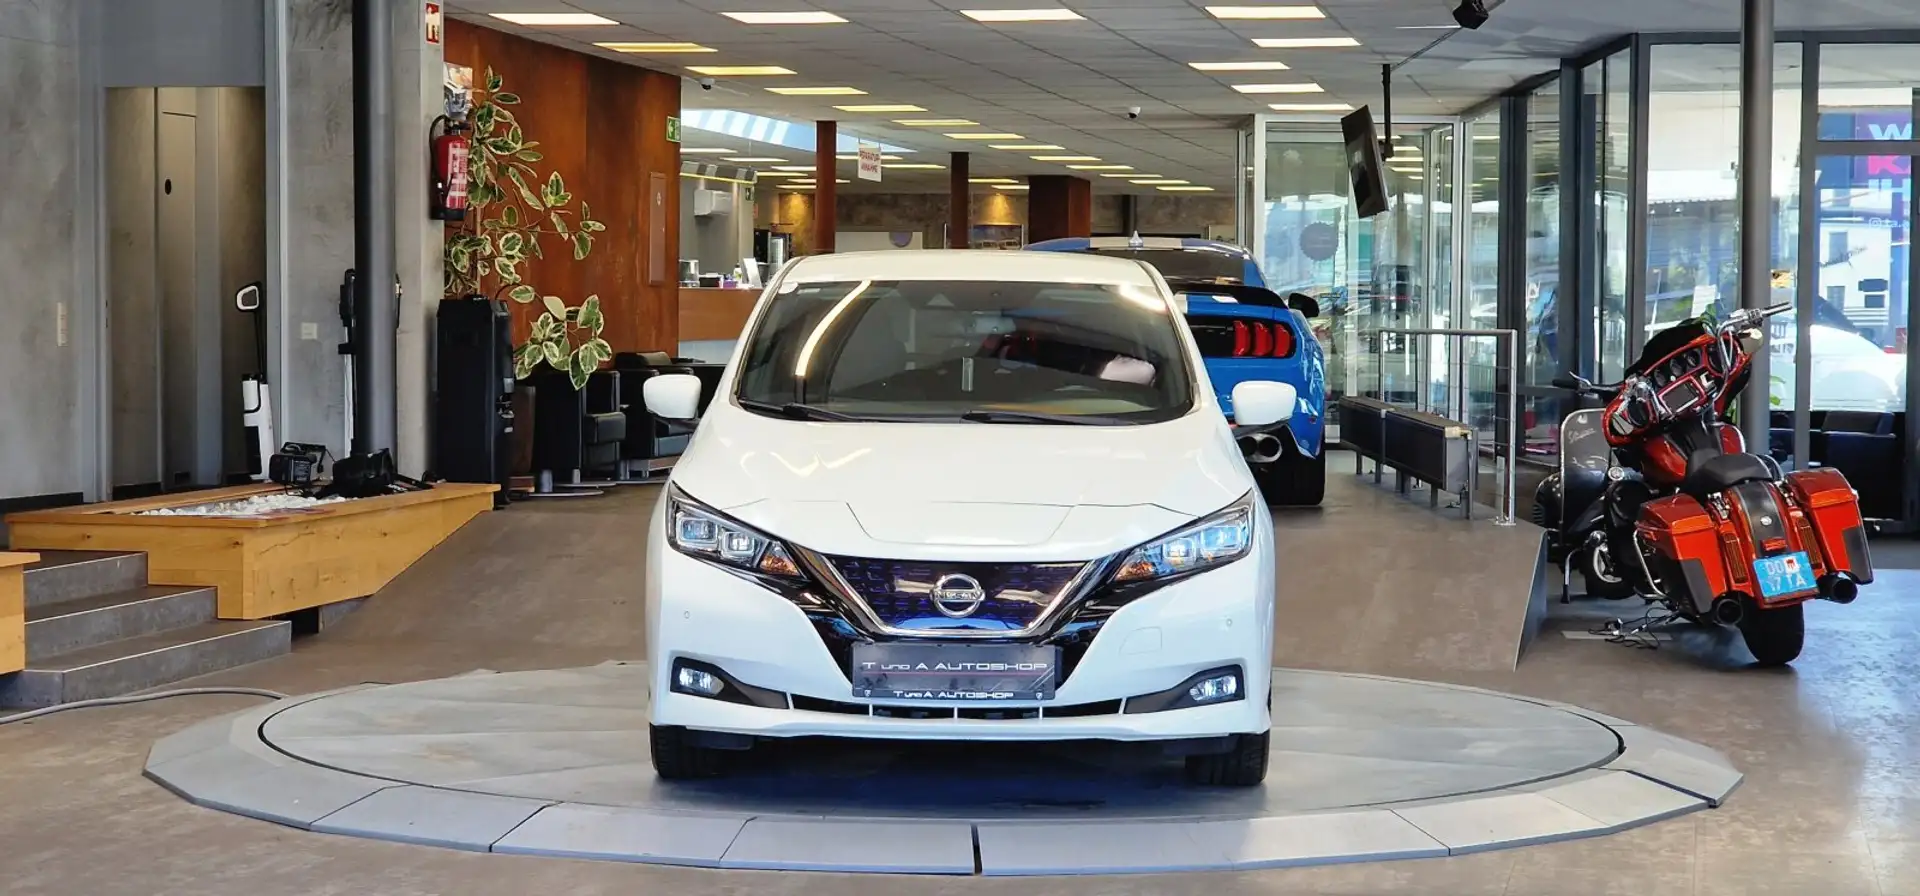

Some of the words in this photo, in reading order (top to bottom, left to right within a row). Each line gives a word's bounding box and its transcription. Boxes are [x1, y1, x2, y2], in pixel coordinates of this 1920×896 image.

[935, 591, 979, 600] NISSAN
[935, 663, 1048, 671] AUTOSHOP
[893, 690, 903, 698] T
[938, 691, 1014, 699] AUTOSHOP
